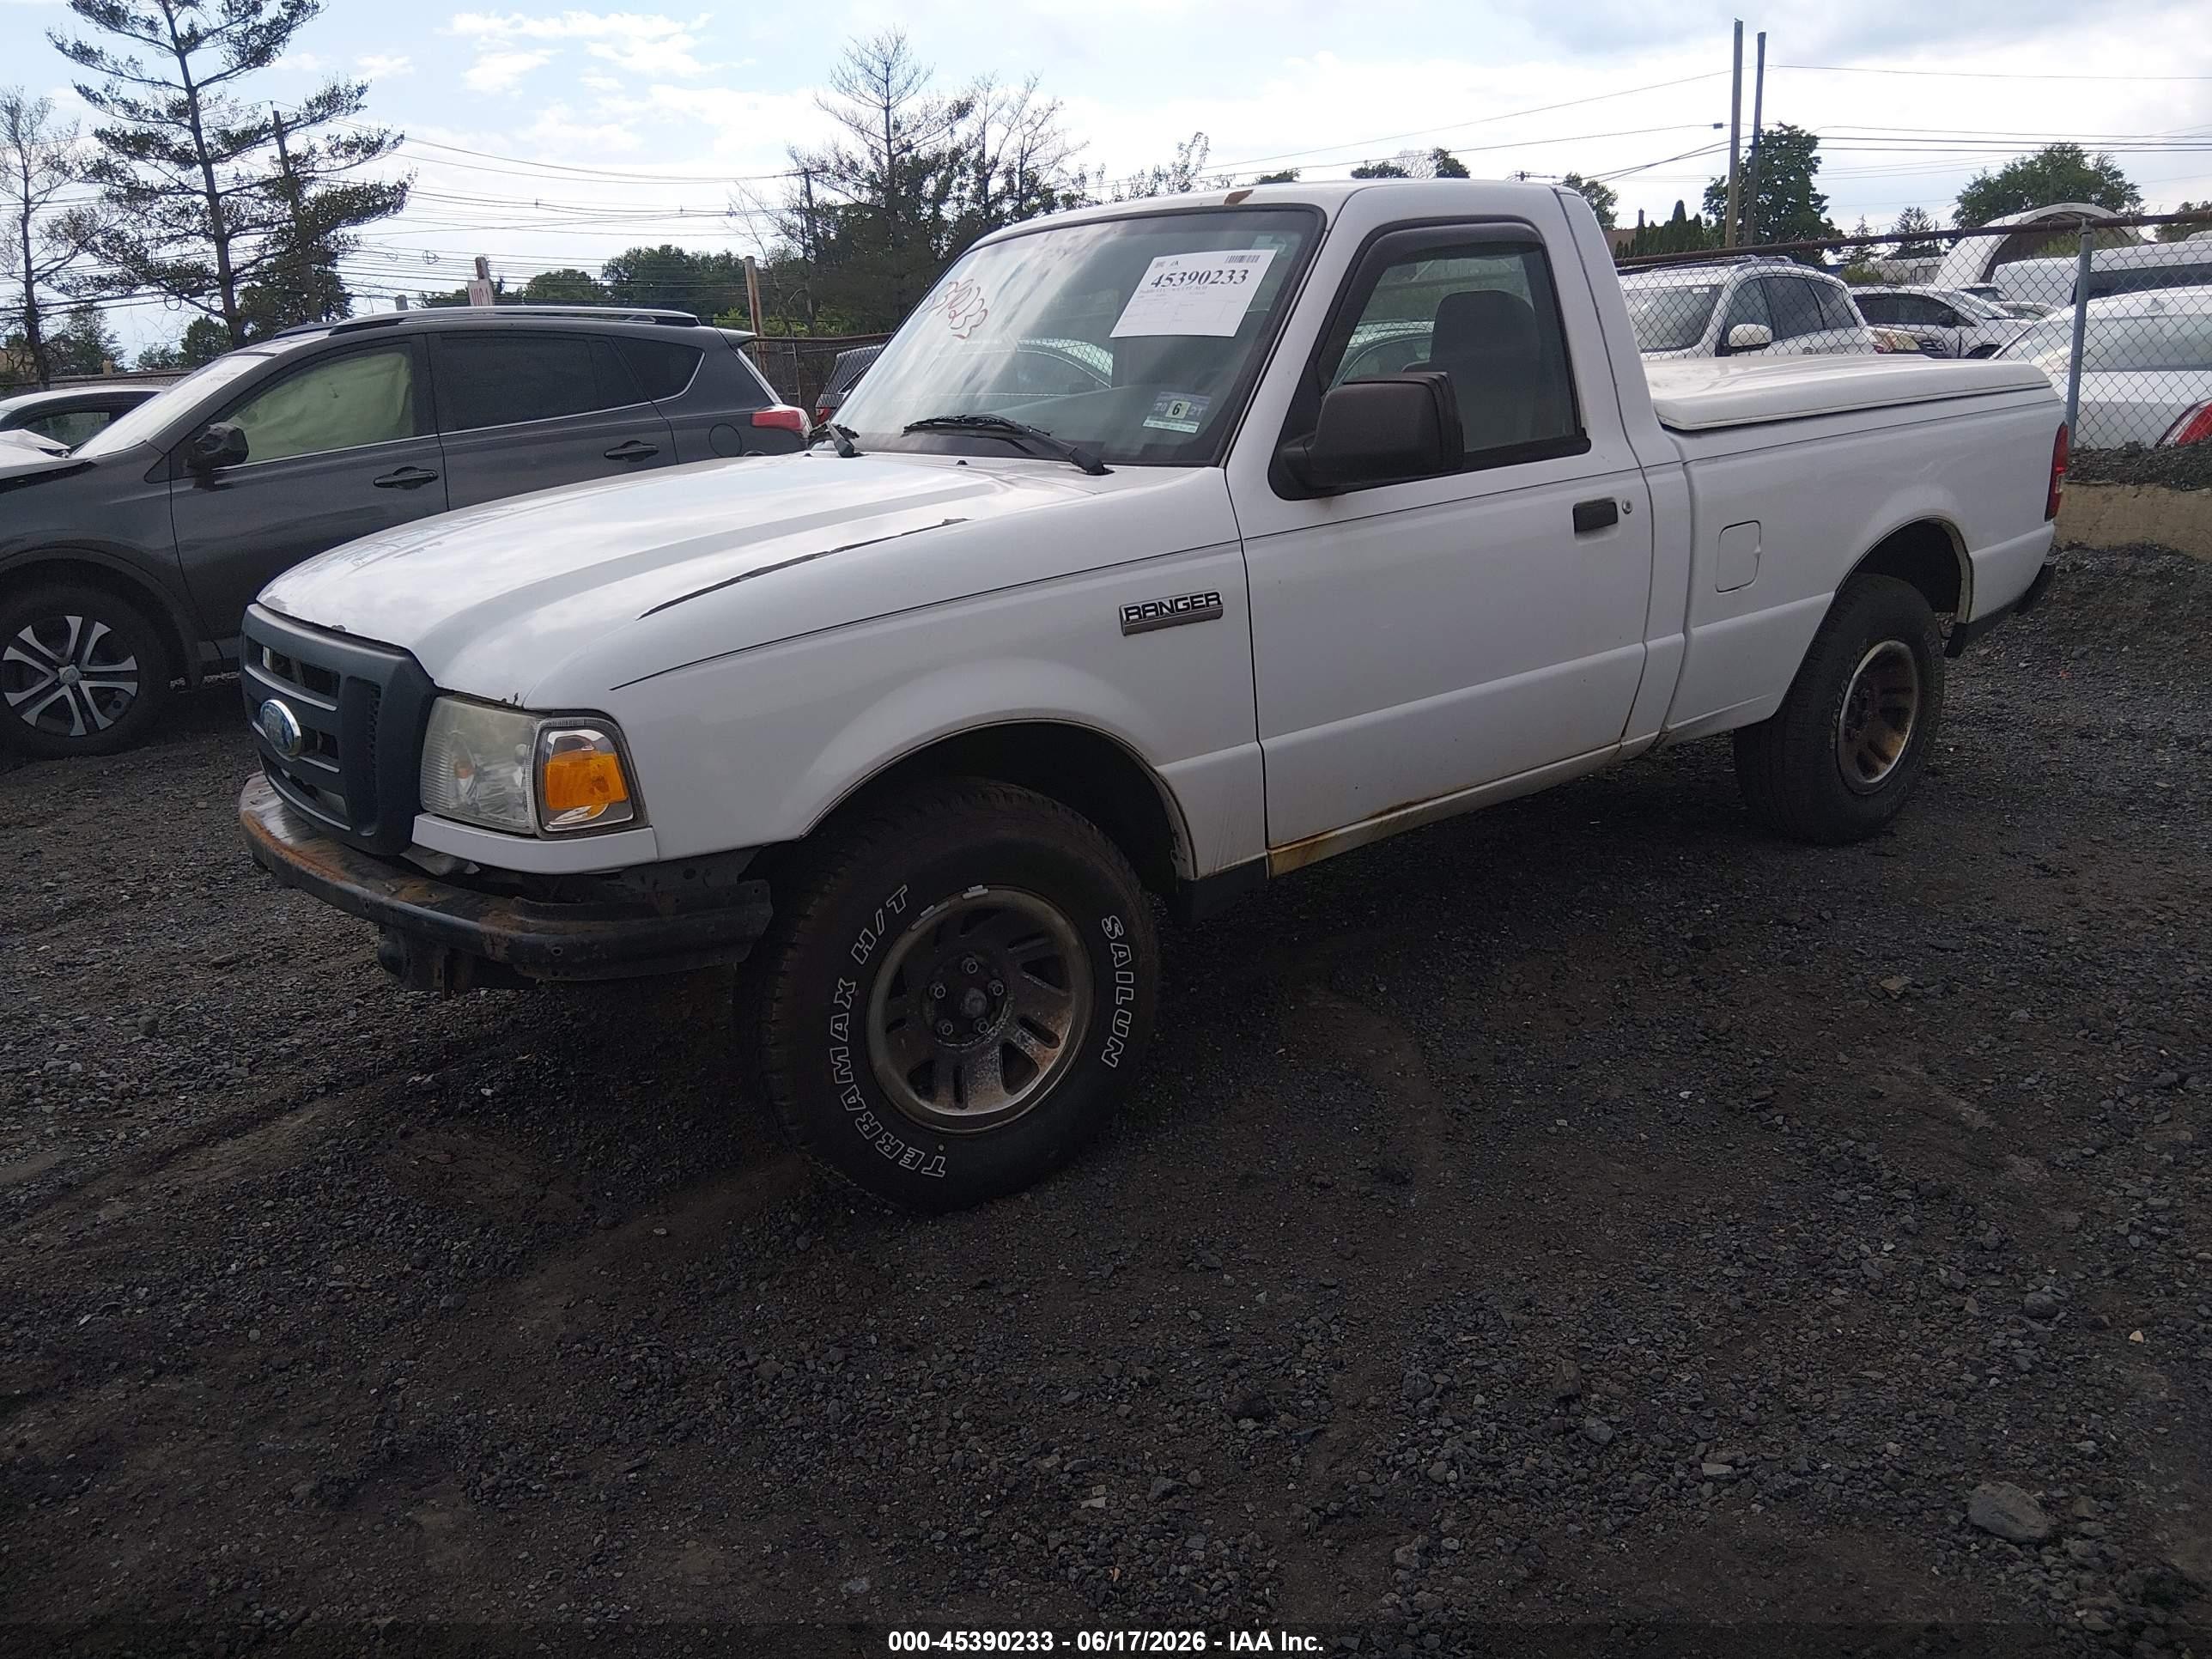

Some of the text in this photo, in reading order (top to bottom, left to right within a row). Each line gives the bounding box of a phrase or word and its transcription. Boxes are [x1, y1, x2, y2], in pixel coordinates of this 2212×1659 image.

[1151, 269, 1249, 288] 45390233
[1172, 403, 1182, 416] 6
[1124, 592, 1223, 623] RANGER
[1101, 915, 1134, 1068] SAILUN
[830, 884, 946, 1177] TERRAMAX H/T
